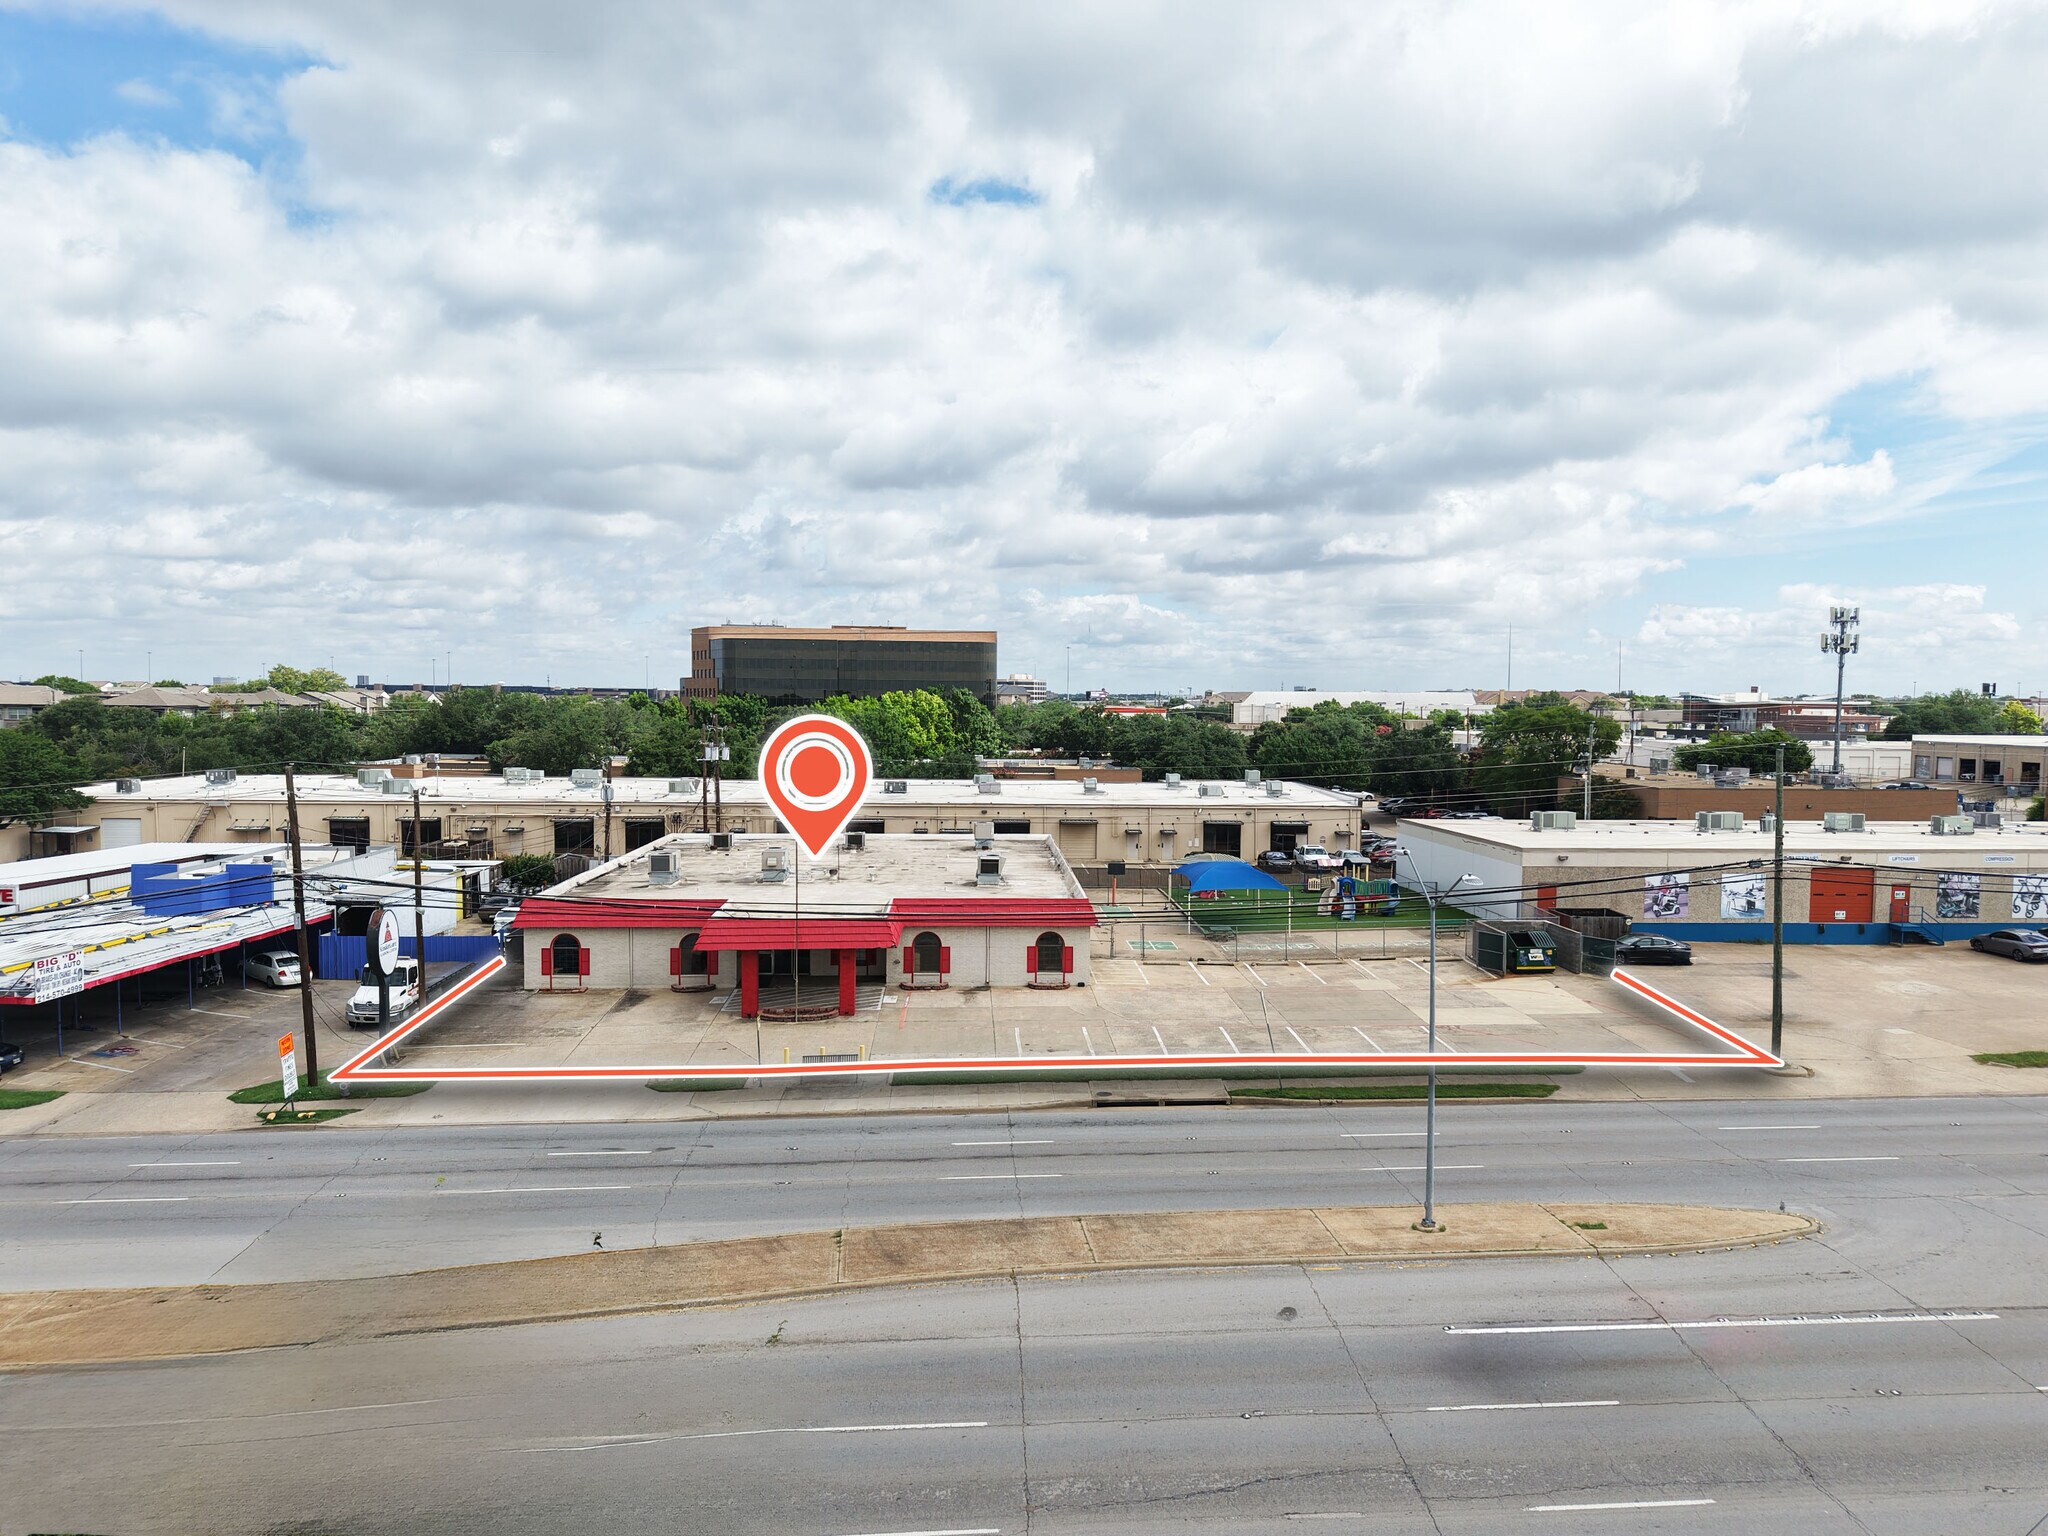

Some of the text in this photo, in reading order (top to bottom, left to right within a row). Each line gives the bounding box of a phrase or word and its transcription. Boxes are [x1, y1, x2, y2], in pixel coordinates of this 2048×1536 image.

[36, 951, 82, 969] BIG "D"
[39, 966, 54, 975] TIRE
[63, 960, 81, 969] AUTO
[37, 984, 82, 1002] 214-570-4999
